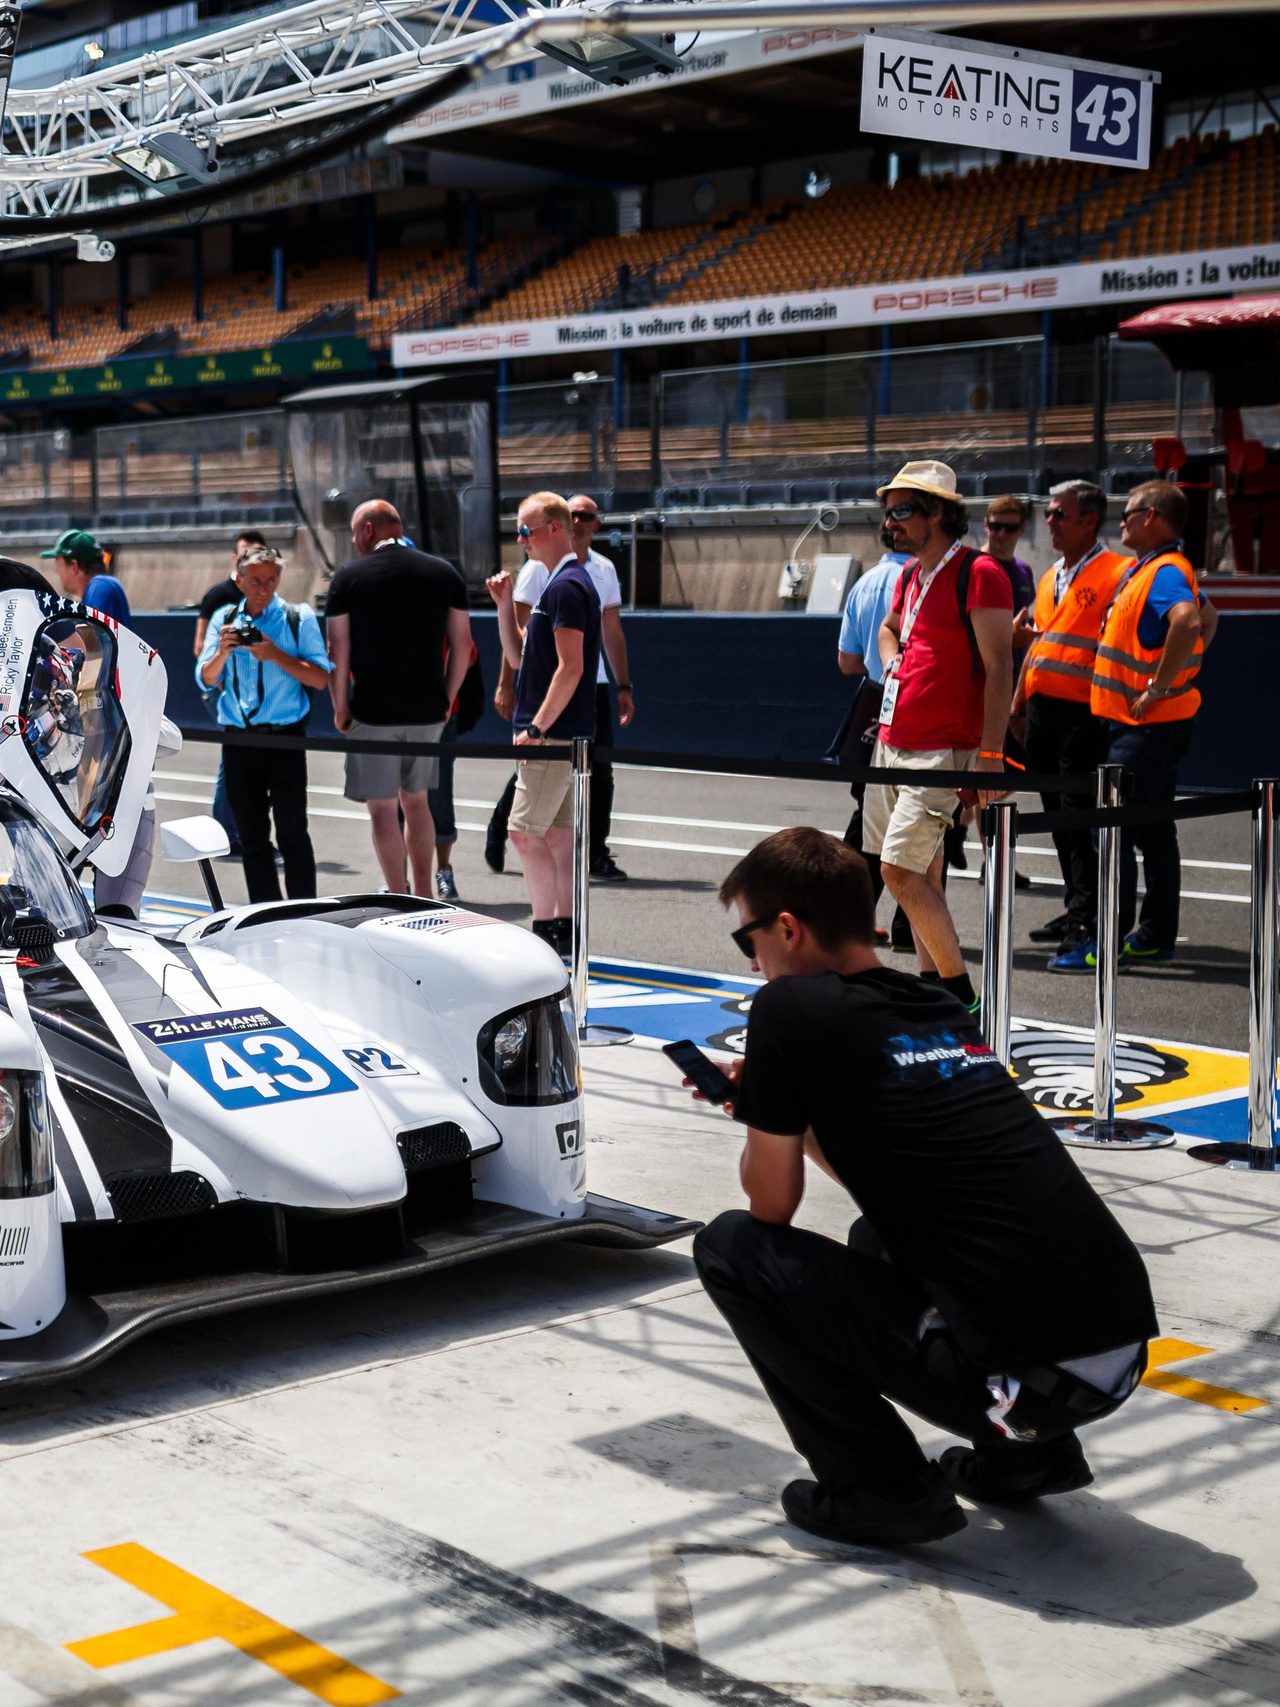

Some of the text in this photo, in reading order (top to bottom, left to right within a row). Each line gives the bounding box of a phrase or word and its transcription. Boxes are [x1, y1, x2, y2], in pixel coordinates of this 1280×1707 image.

[878, 52, 1061, 115] KEATING
[877, 94, 1059, 133] MOTORSPORTS
[1075, 84, 1137, 146] 43
[872, 277, 1059, 314] PORSCHE
[1101, 266, 1178, 294] Mission
[1200, 260, 1220, 284] la
[409, 332, 531, 357] PORSCHE
[558, 327, 608, 346] Mission
[621, 322, 634, 340] la
[638, 317, 686, 338] voiture
[691, 314, 708, 332] de
[712, 310, 752, 333] sport
[757, 307, 775, 326] de
[780, 301, 837, 323] demain
[0, 637, 24, 695] Ricky Taylor
[148, 1014, 270, 1038] 24h LE MANS
[203, 1034, 332, 1099] 43
[341, 1047, 407, 1072] P2
